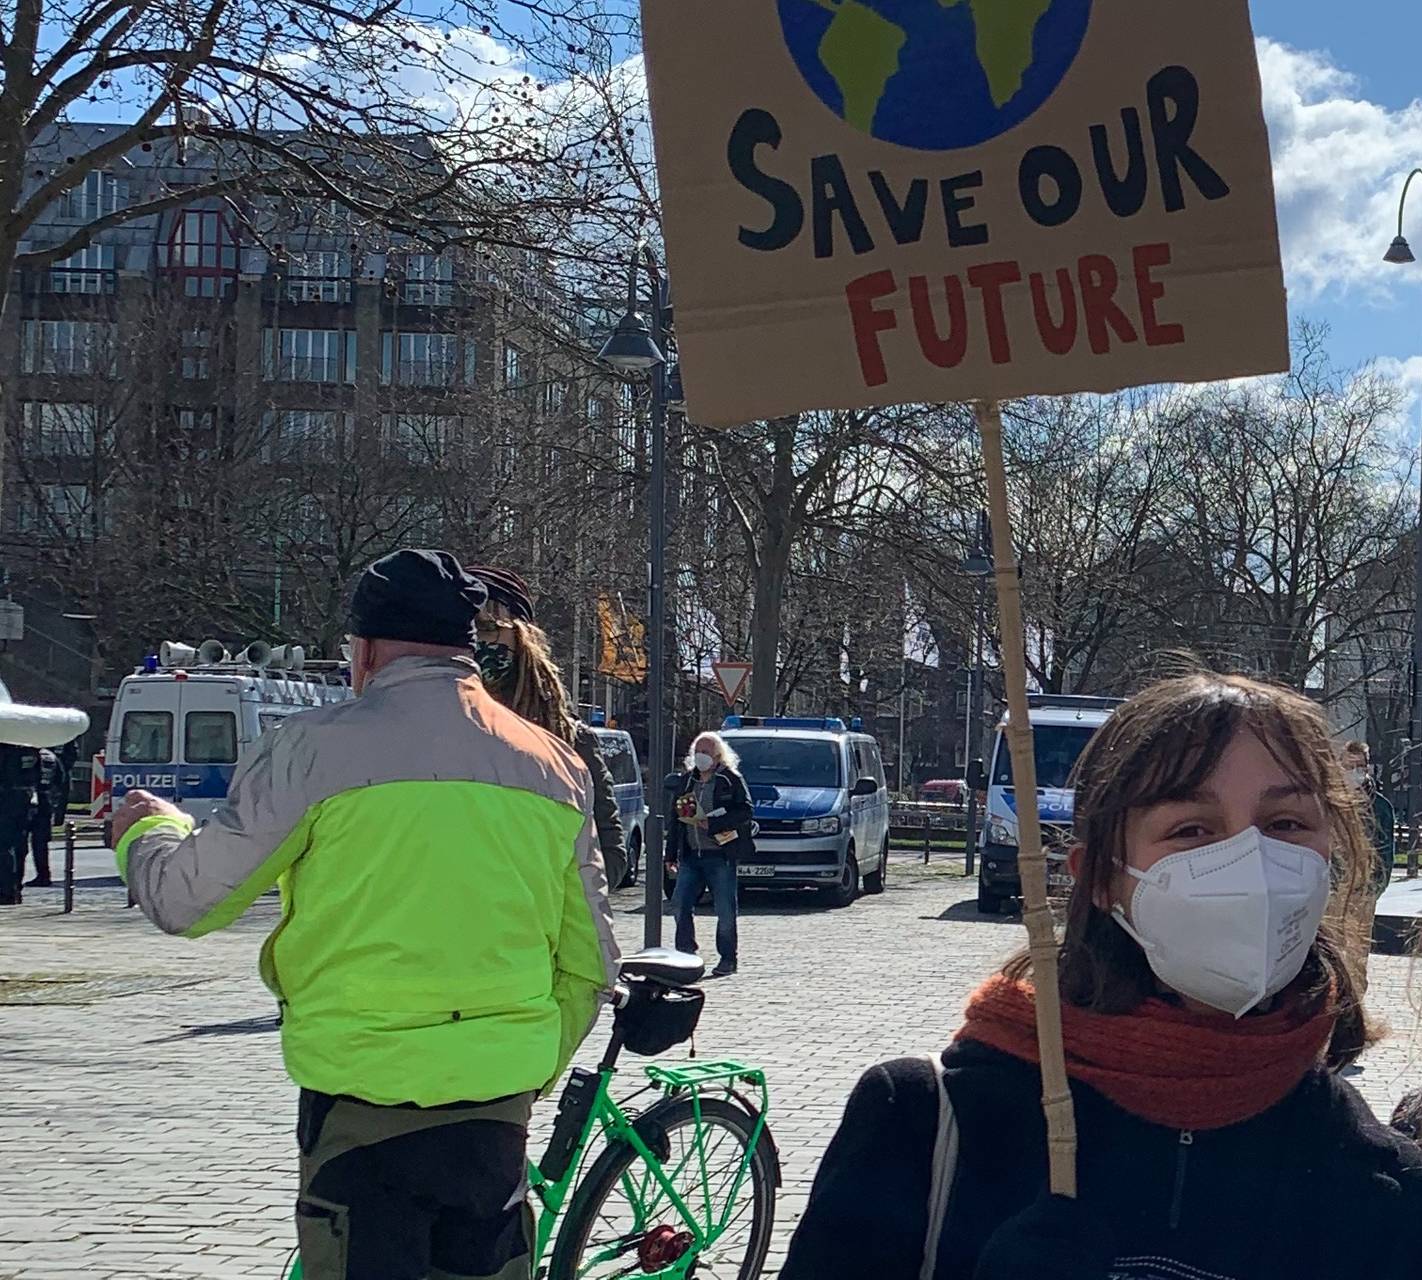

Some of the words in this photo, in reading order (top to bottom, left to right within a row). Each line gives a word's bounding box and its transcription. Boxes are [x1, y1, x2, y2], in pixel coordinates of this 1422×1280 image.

[727, 108, 990, 258] SAVE
[1019, 65, 1230, 228] OUR
[845, 242, 1185, 388] FUTURE
[112, 774, 177, 788] POLIZEI
[755, 800, 791, 810] IZEI
